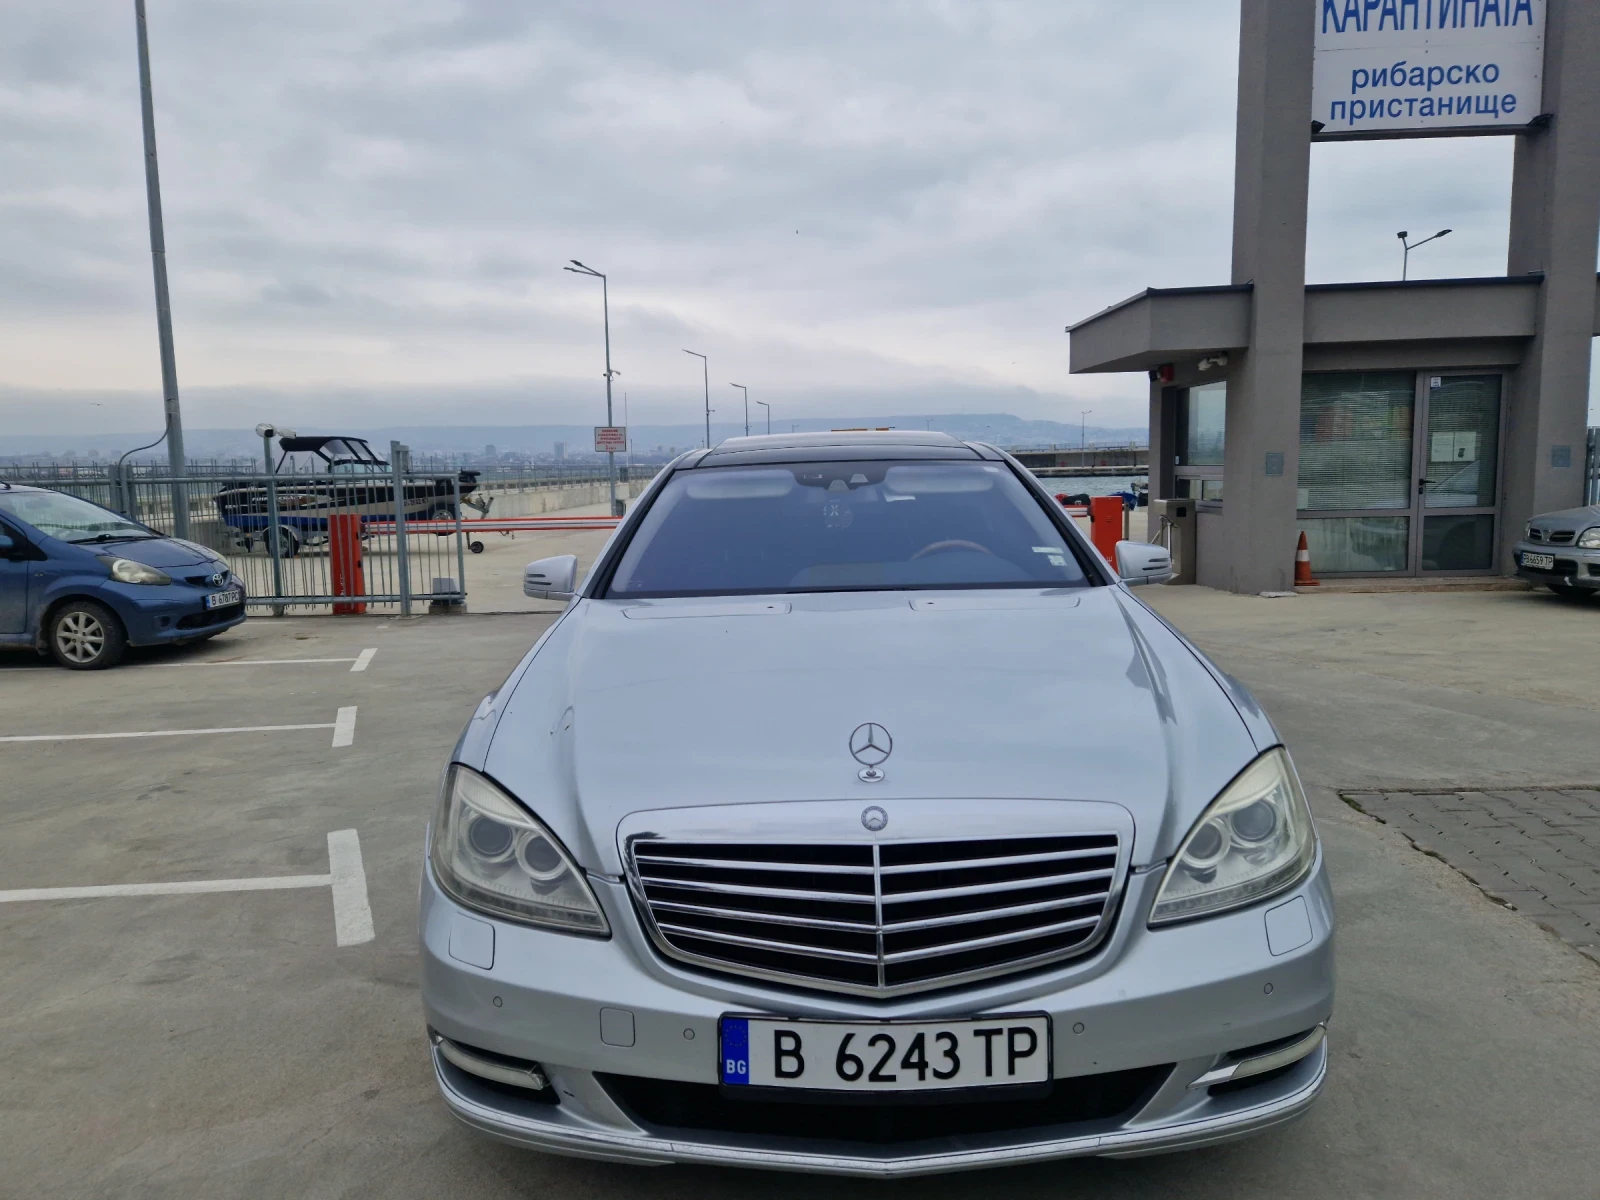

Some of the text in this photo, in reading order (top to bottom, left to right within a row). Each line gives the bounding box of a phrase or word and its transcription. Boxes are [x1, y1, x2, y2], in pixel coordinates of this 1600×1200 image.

[1351, 60, 1500, 94] рибарско
[1330, 93, 1517, 125] пристанище
[726, 1058, 747, 1075] BG
[774, 1026, 1038, 1083] B 6243 TP
